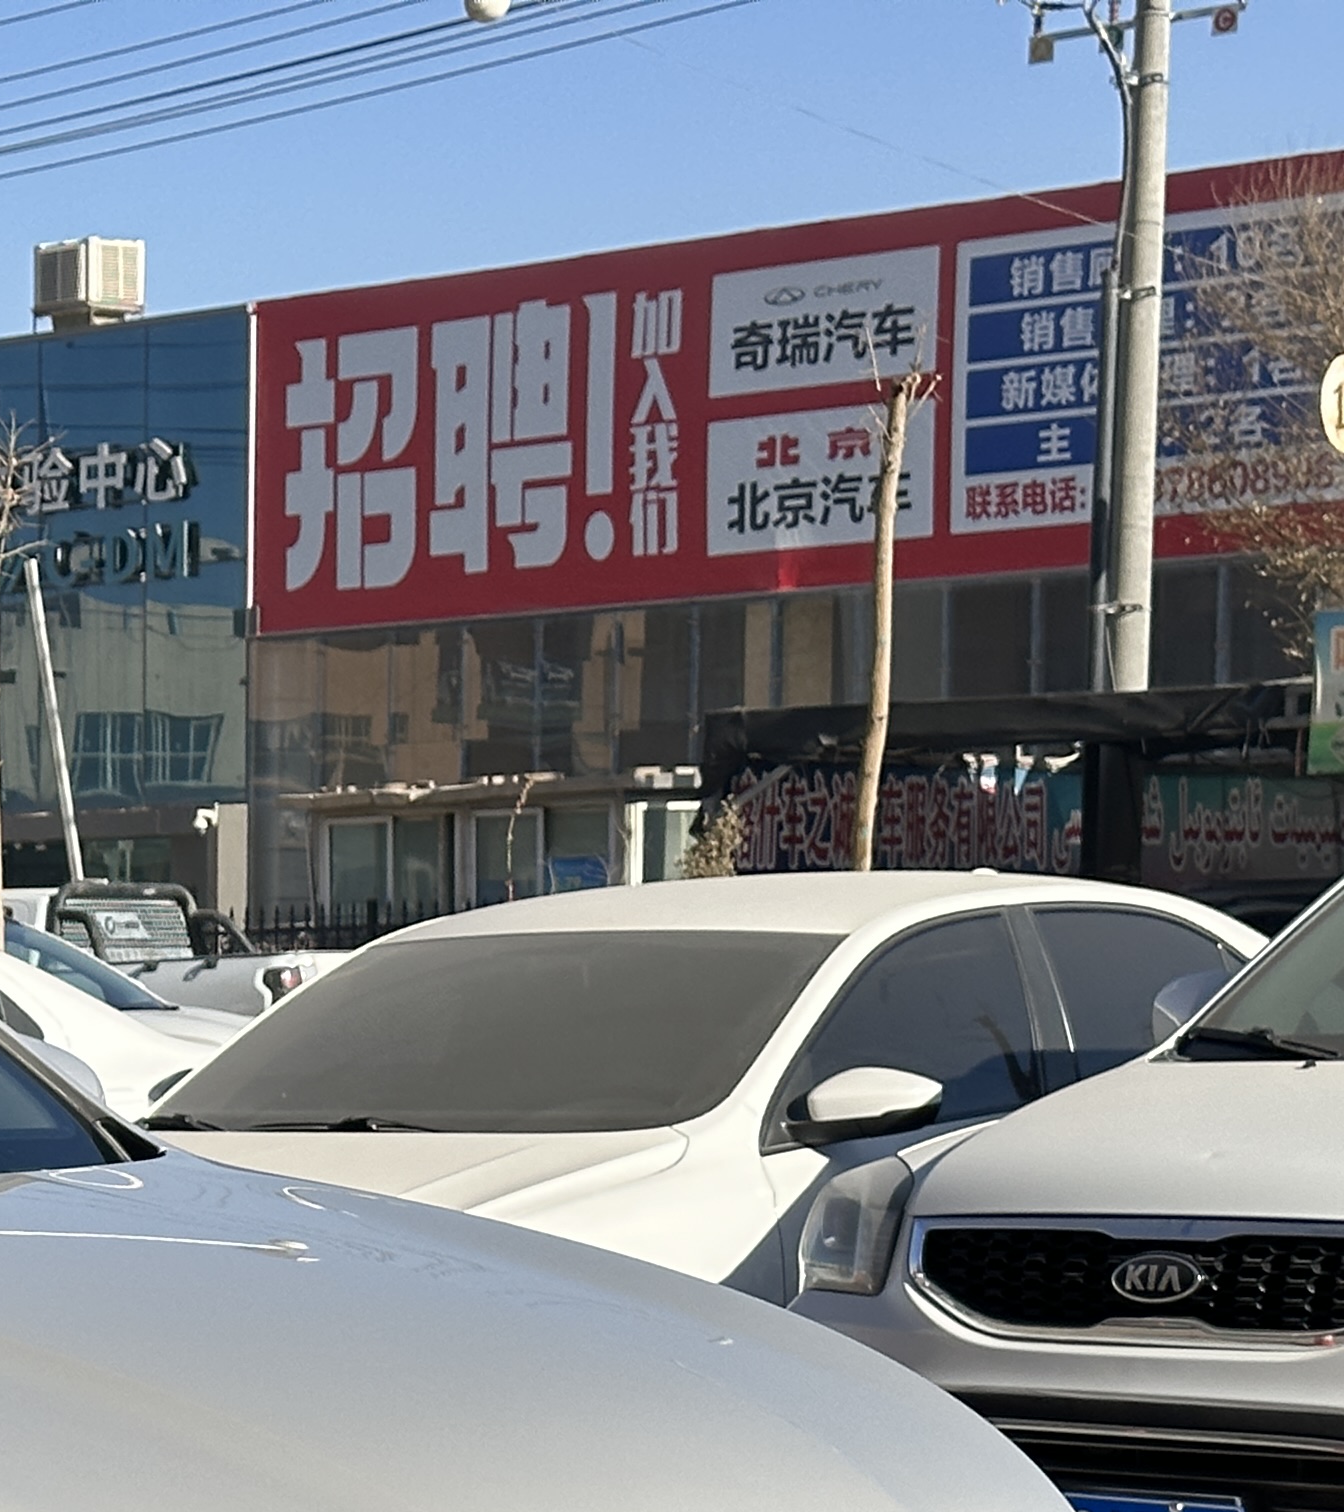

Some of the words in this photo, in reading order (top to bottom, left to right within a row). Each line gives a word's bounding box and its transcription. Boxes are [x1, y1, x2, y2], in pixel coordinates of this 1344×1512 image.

[813, 279, 884, 298] CHERY
[731, 303, 915, 371] 奇瑞汽车
[285, 291, 617, 592] 招聘!
[629, 288, 683, 557] 加入我们
[755, 427, 871, 469] 北京
[727, 471, 912, 534] 北京汽车
[1124, 1263, 1182, 1293] KIA
